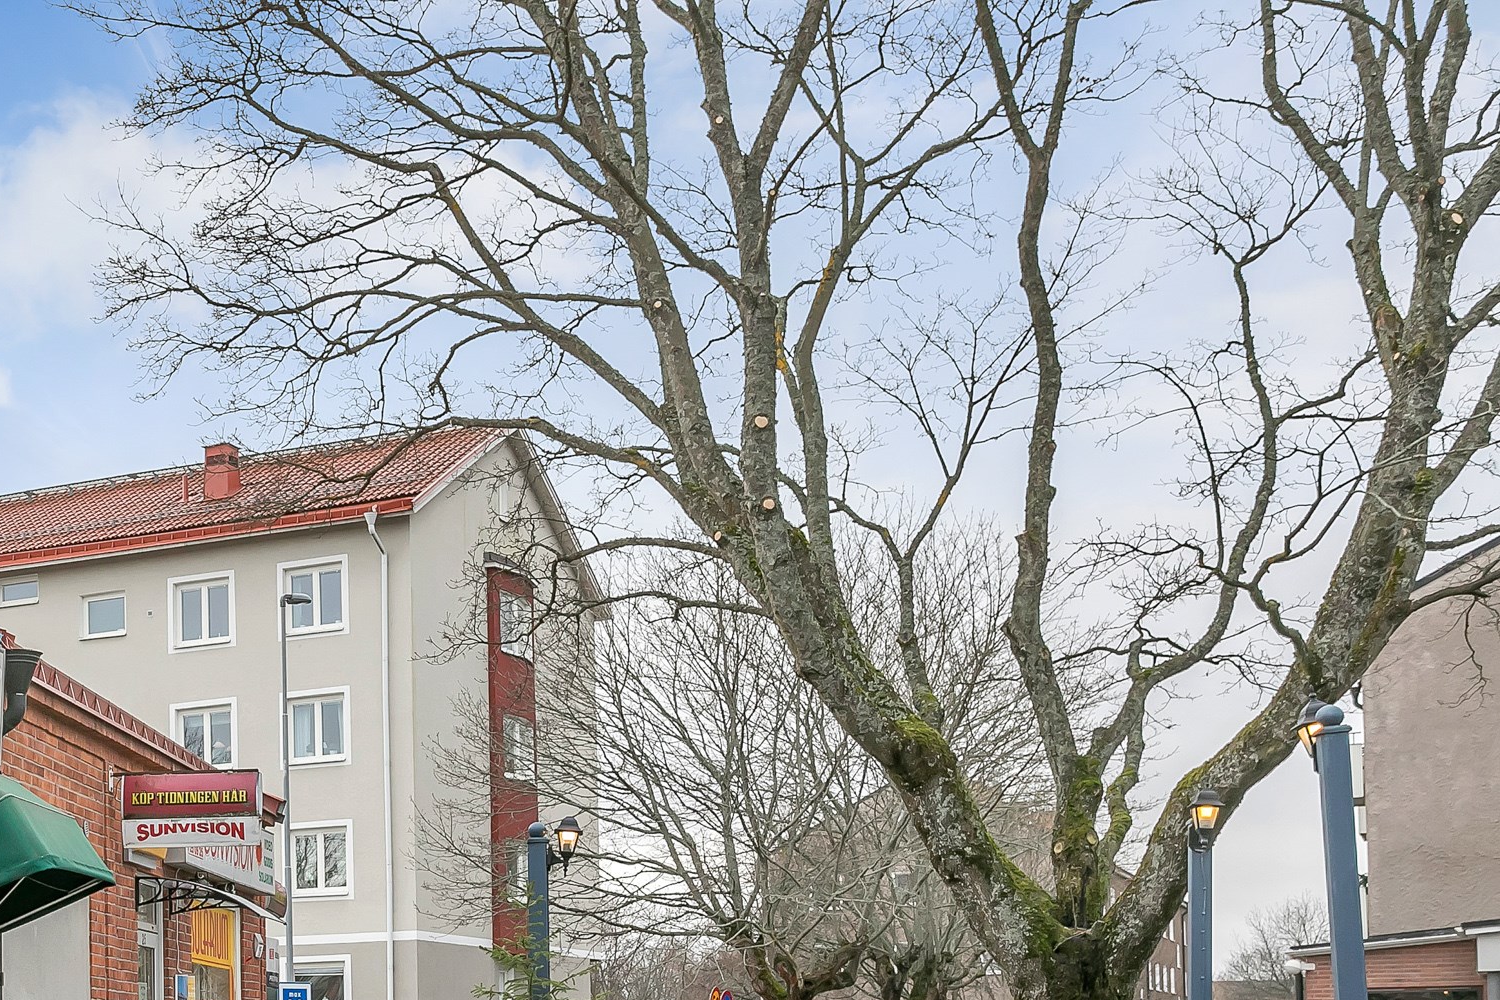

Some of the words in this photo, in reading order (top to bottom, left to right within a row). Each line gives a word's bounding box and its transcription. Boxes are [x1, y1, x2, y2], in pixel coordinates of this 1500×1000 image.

[131, 791, 154, 806] KÖP
[156, 789, 220, 805] TIDNINGEN
[221, 787, 248, 804] HÄR
[136, 821, 246, 842] SUNVISION
